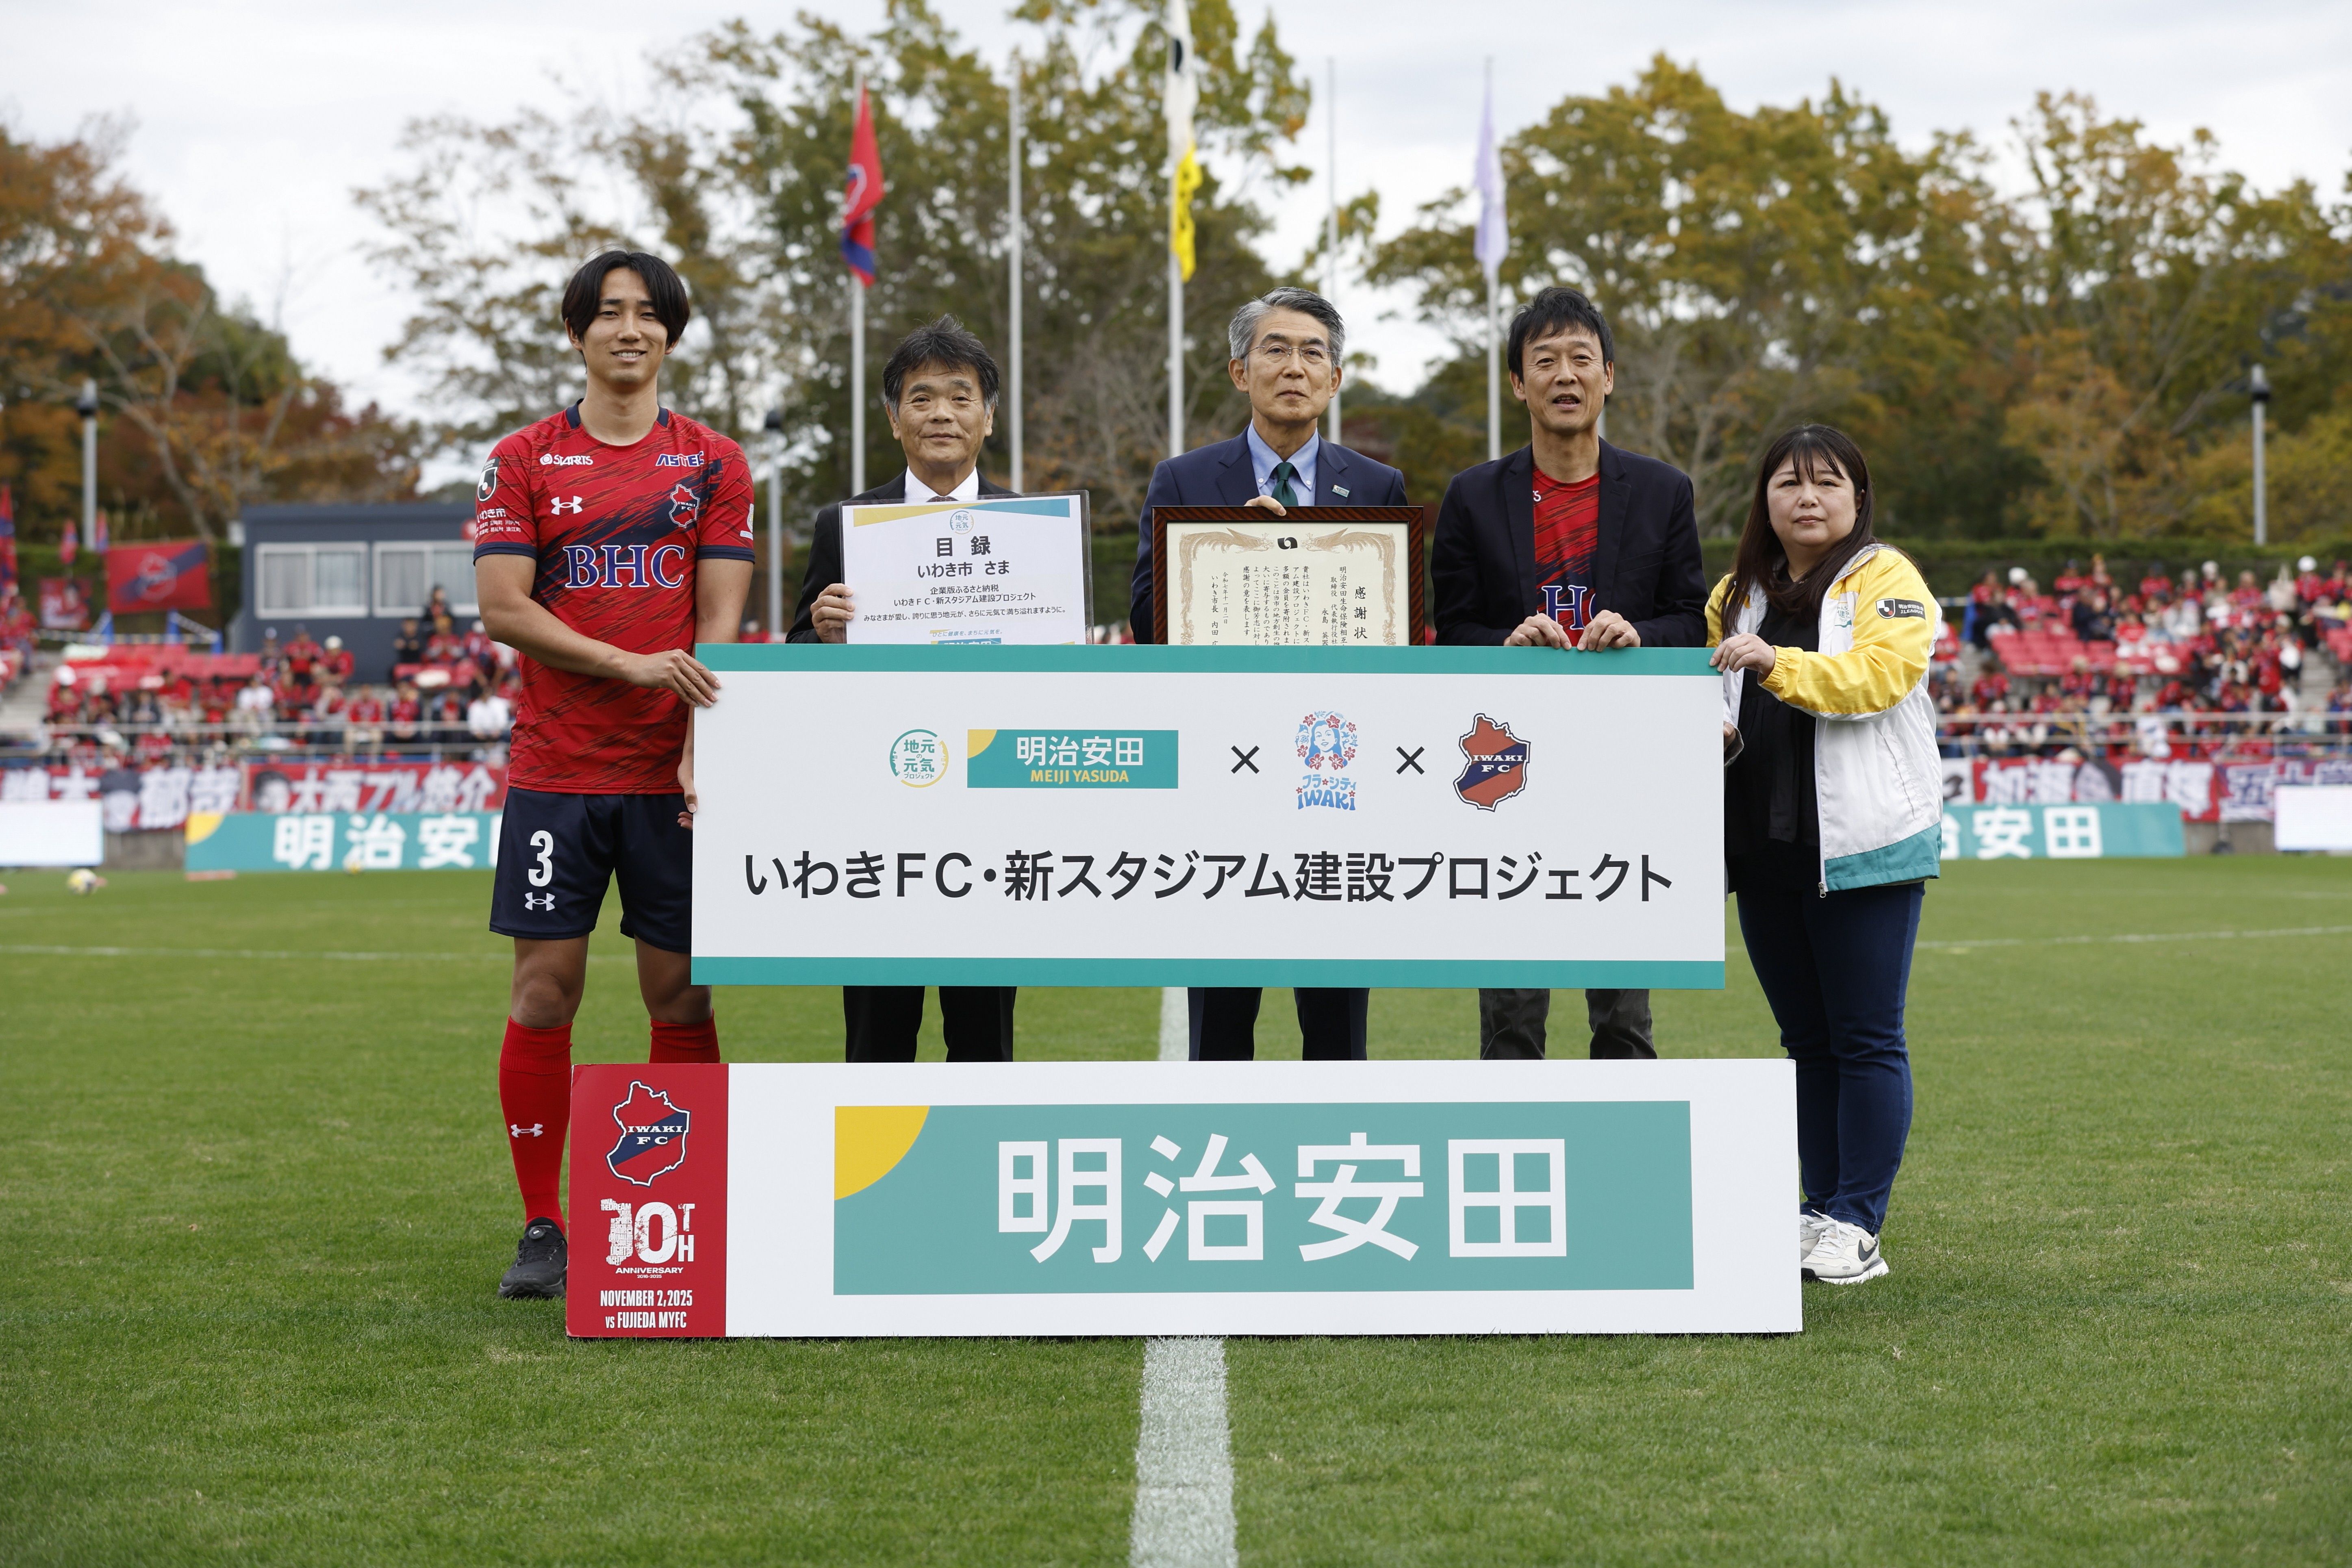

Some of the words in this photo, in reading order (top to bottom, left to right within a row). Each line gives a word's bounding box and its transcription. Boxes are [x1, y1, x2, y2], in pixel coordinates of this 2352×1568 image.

[477, 508, 506, 523] いわき市
[563, 545, 685, 588] BHC
[918, 562, 973, 578] いわき市
[984, 560, 1010, 575] さま
[930, 584, 999, 595] 企業版ふるさと納税
[894, 592, 1036, 606] いわきFC・新スタジアム建設プロジェクト
[1242, 566, 1251, 636] 感謝の意を表します
[1340, 567, 1348, 645] 明治安田生命保険相互
[1322, 608, 1329, 624] 永島
[1354, 586, 1368, 639] 感謝状
[1212, 621, 1218, 635] 内田
[903, 739, 935, 753] 地元
[1017, 736, 1143, 766] 明治安田
[903, 758, 935, 772] 元気
[1031, 770, 1070, 784] MEIJI
[1074, 770, 1129, 782] YASUDA
[273, 813, 503, 870] 明治安
[528, 830, 554, 887] 3
[745, 849, 1672, 902] いわきFC・新スタジアム建設プロジェクト
[999, 1132, 1567, 1263] 明治安田
[600, 1290, 654, 1306] NOVEMBER
[617, 1312, 656, 1328] FUJIEDA
[659, 1312, 687, 1328] MYFC
